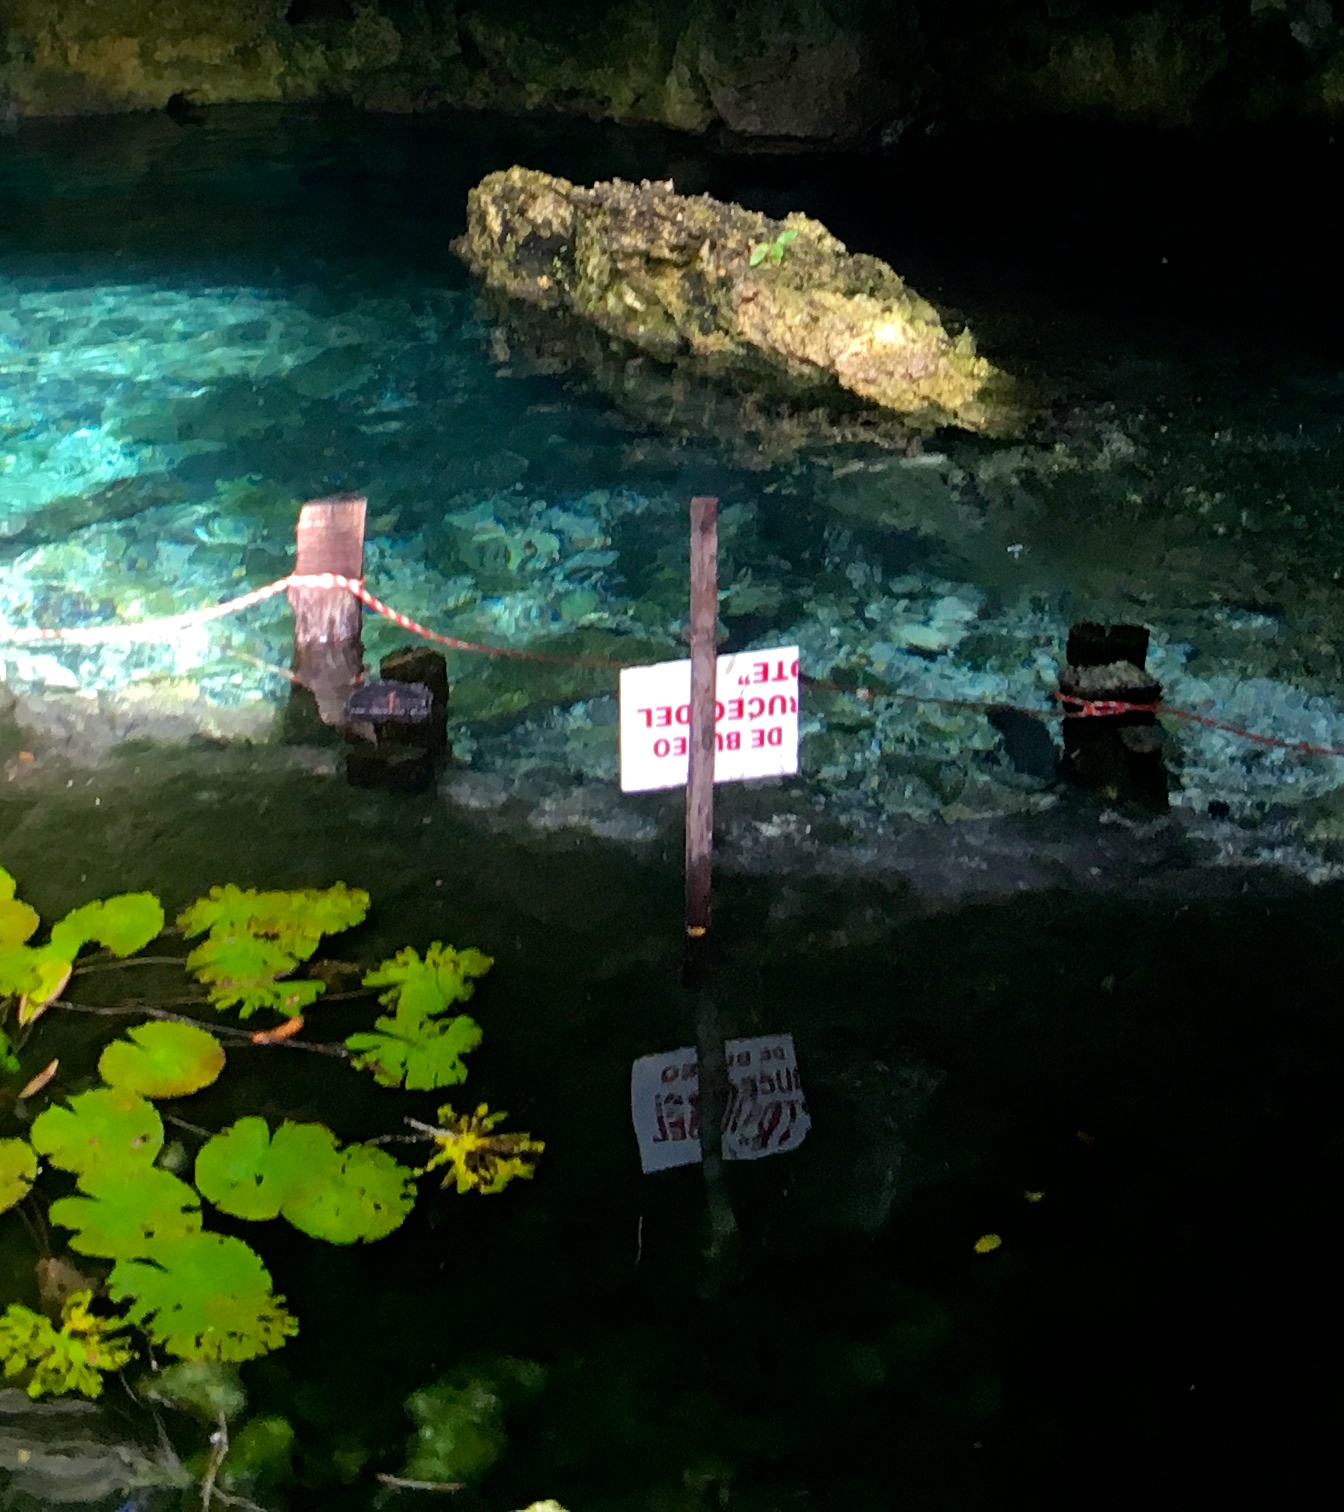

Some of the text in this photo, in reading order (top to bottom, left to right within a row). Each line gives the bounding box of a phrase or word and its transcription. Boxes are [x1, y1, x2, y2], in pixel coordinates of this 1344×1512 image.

[637, 704, 691, 728] DEL
[653, 726, 783, 758] DE BUEO
